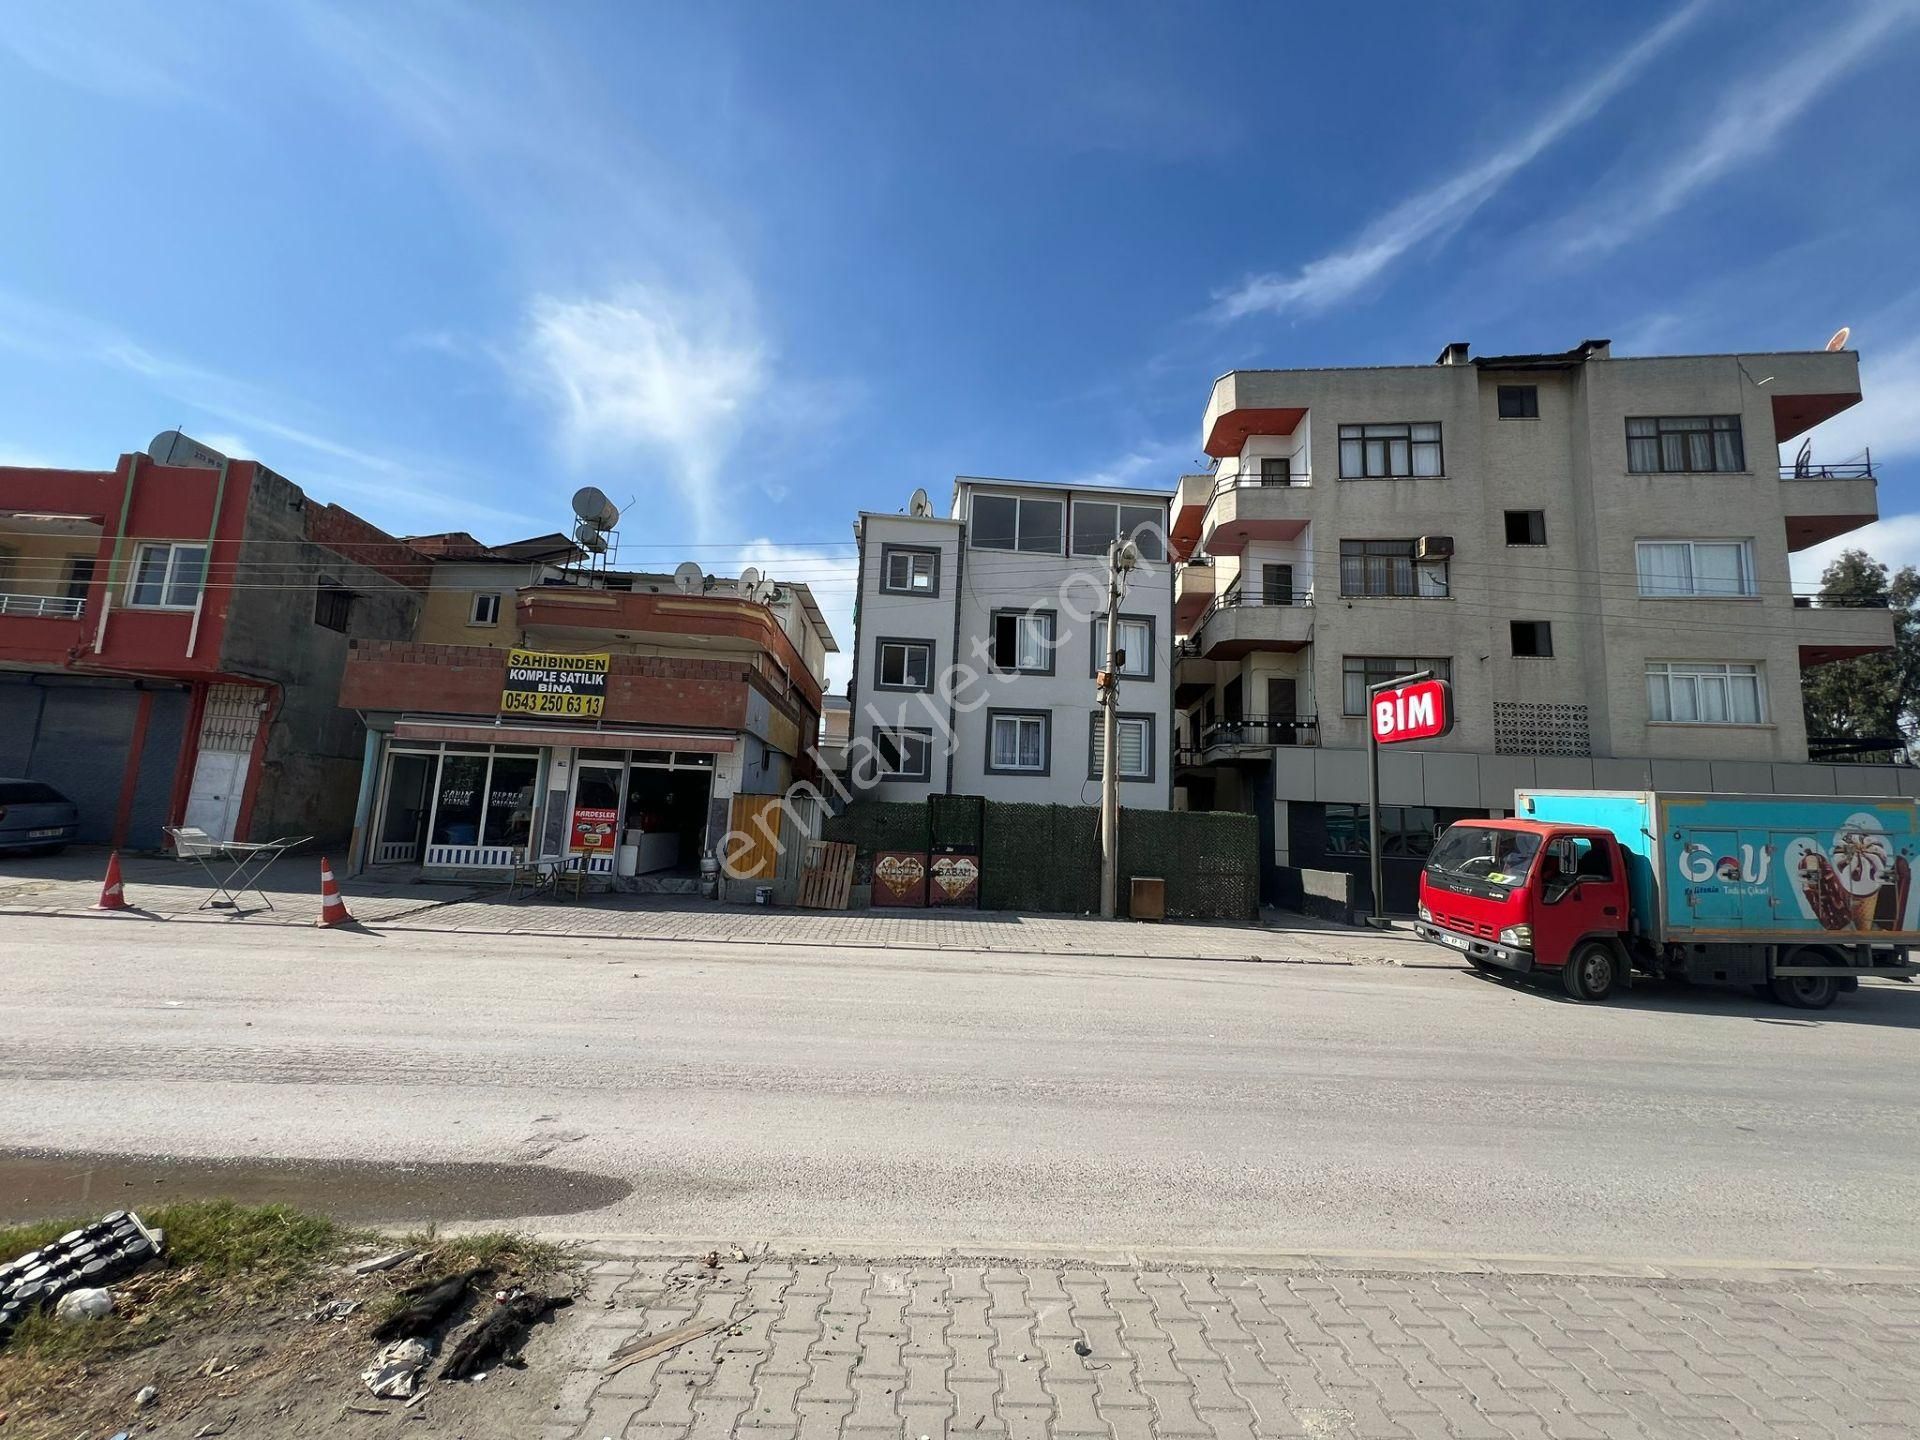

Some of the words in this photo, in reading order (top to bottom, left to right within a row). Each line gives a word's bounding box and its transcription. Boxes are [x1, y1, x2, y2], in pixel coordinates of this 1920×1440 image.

[509, 669, 557, 683] KOMPLE
[560, 673, 604, 686] SATILIK
[538, 682, 573, 694] BİNA
[506, 693, 537, 710] 0543
[540, 695, 562, 712] 250
[567, 697, 581, 713] 63
[586, 698, 600, 714] 13
[1376, 688, 1435, 735] BİM
